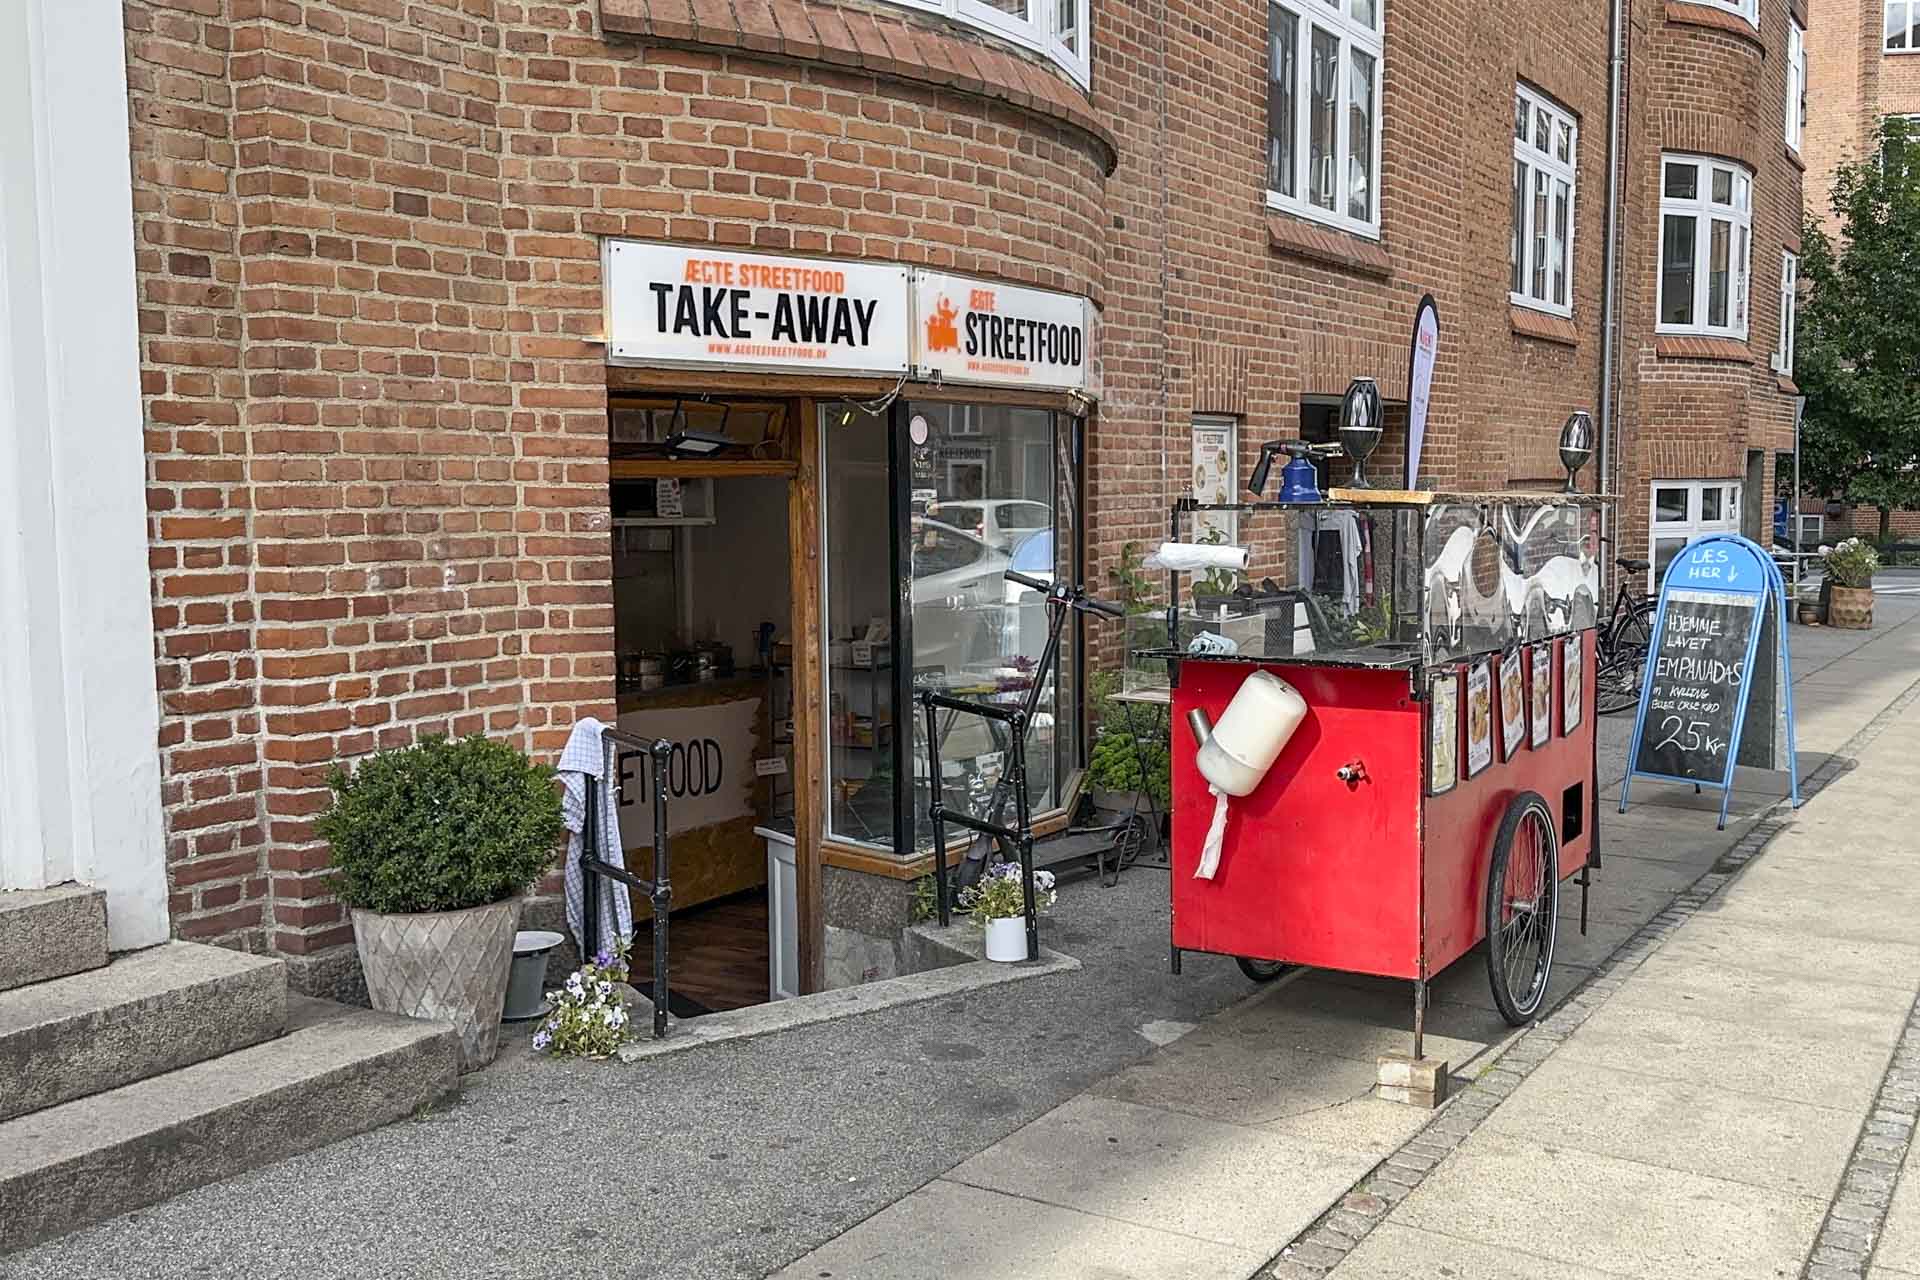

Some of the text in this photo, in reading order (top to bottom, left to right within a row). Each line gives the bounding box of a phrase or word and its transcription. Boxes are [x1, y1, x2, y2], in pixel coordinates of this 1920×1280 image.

[739, 264, 844, 293] STREETFOOD
[650, 282, 877, 347] TAKE-AWAY
[965, 311, 1082, 366] STREETFOOD
[1692, 549, 1729, 564] LÆS
[1688, 566, 1721, 579] HER
[1668, 613, 1722, 636] HJEMME
[1666, 634, 1712, 650] LAVET
[1655, 656, 1744, 686] EMPANADAS
[1655, 715, 1710, 751] 25
